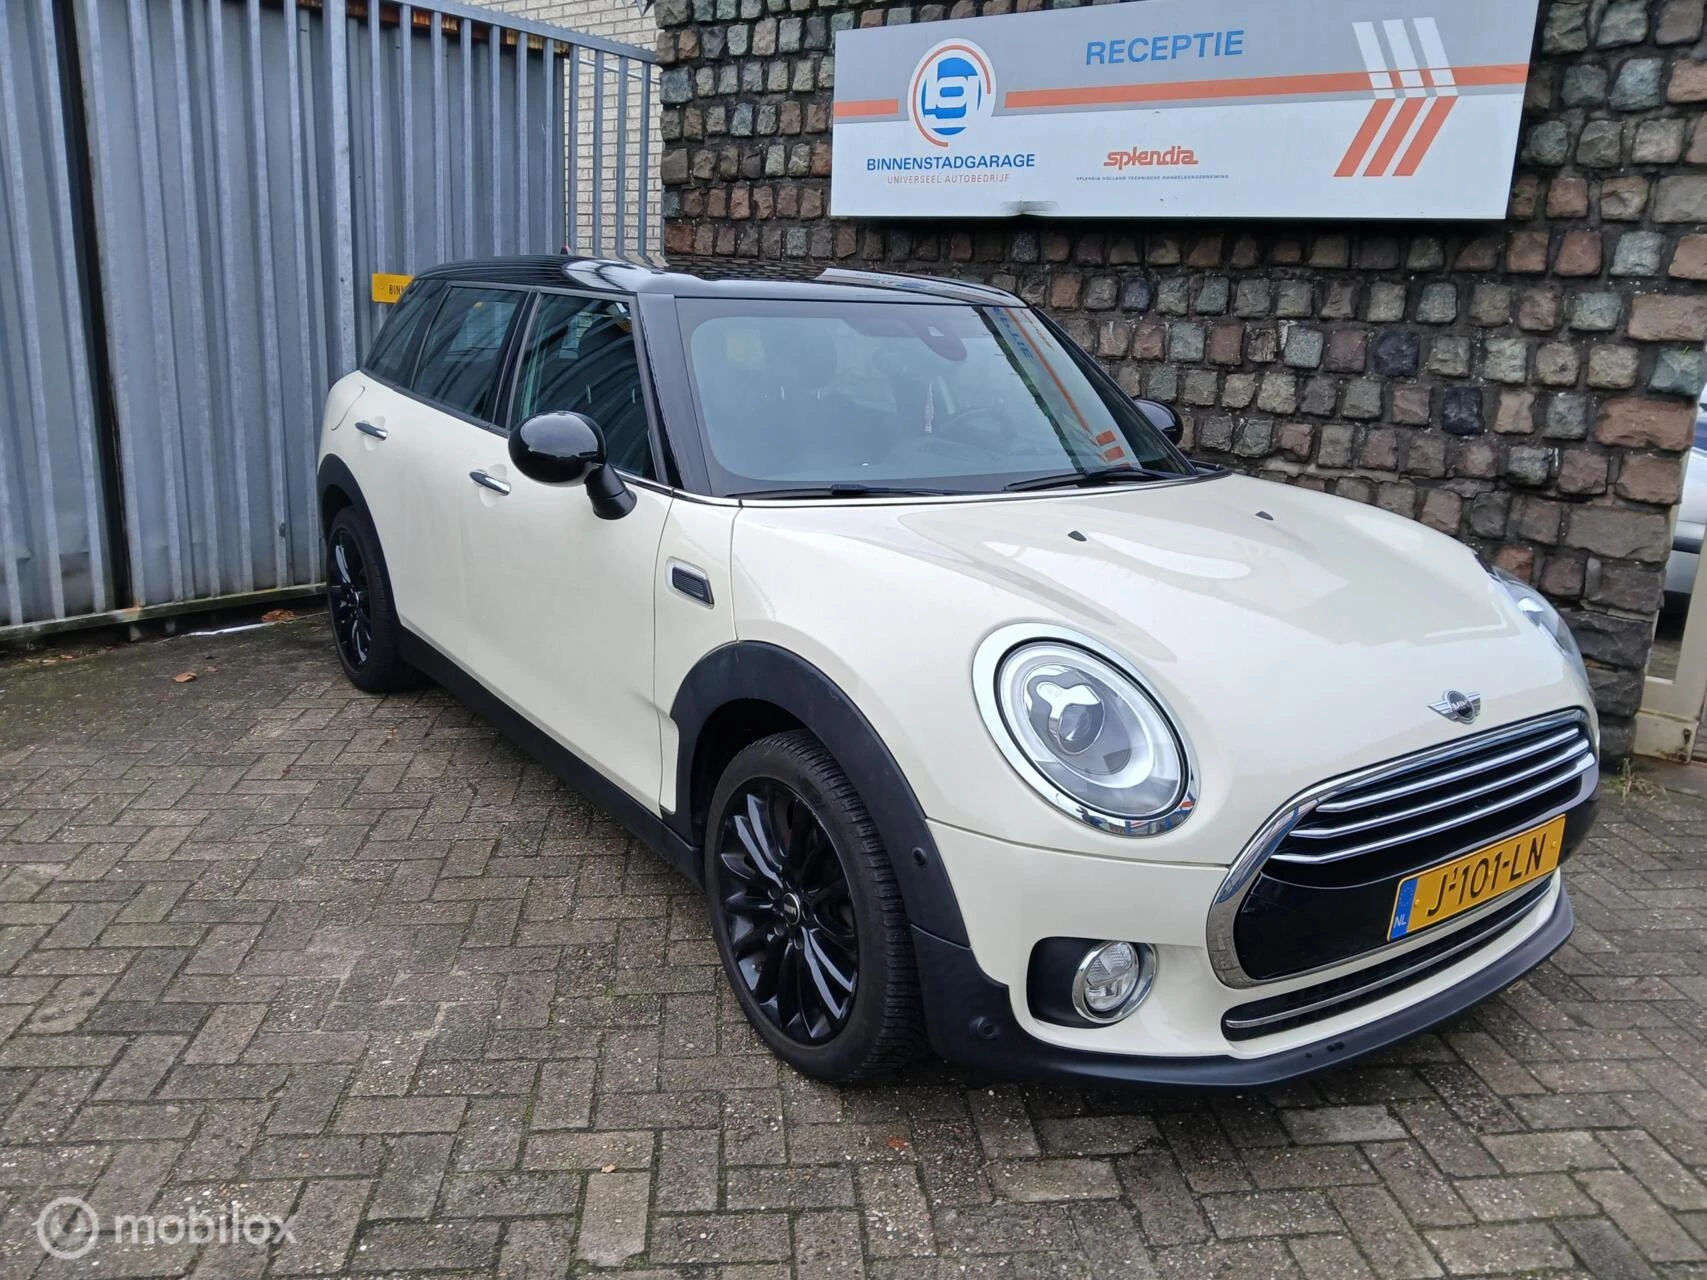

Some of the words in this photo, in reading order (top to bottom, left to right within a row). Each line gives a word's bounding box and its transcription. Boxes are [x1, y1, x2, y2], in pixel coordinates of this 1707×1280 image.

[1086, 30, 1244, 65] RECEPTIE
[866, 153, 1036, 171] BINNENSTADGARAGE
[1103, 146, 1199, 170] splendia
[887, 174, 942, 184] UNIVERSEEL
[944, 173, 1009, 184] AUTOBEDRIJF
[1426, 832, 1547, 917] J-101-LN
[1393, 913, 1407, 929] NL
